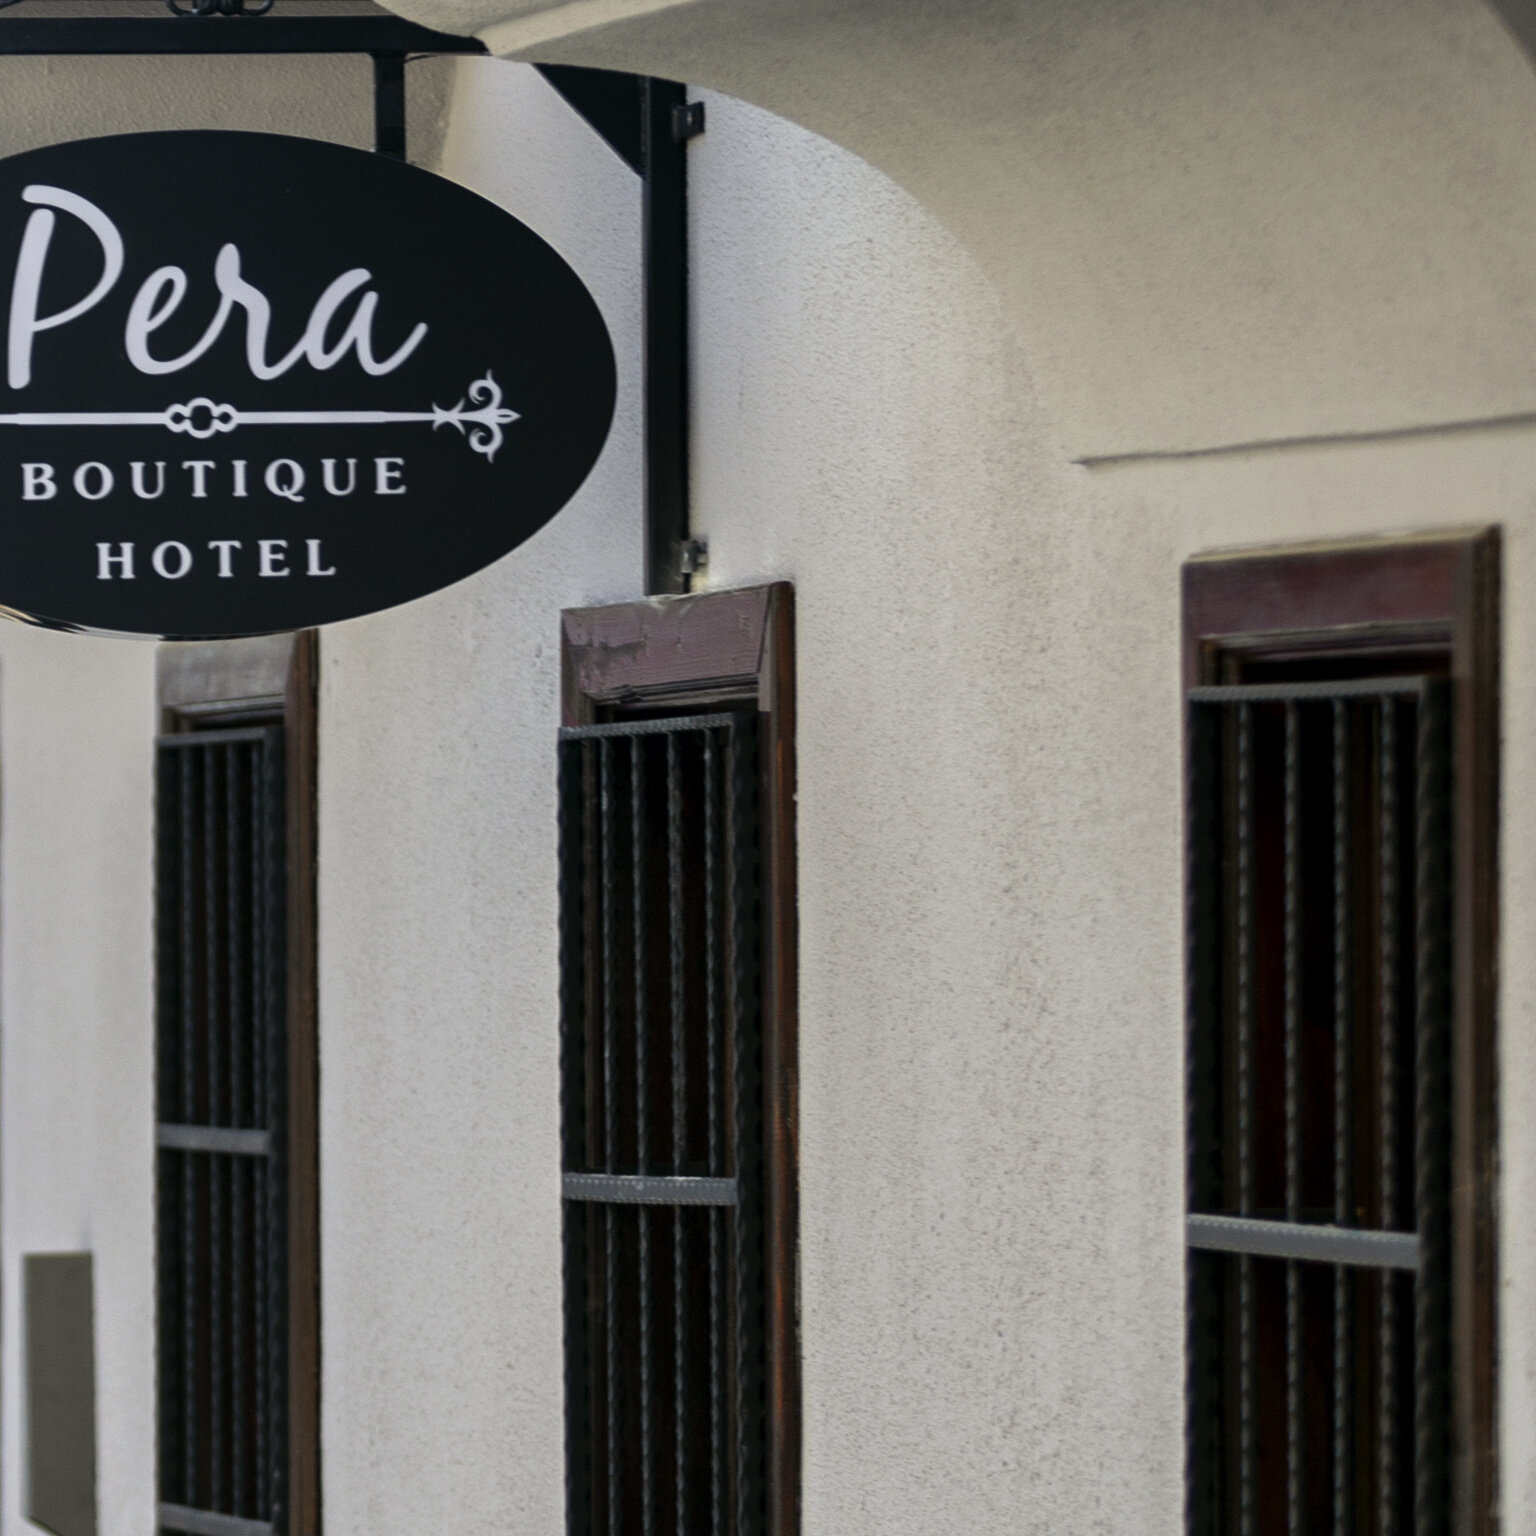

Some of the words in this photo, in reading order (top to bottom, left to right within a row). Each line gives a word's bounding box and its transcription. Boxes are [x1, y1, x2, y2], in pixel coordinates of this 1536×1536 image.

[7, 183, 428, 390] Pera
[20, 456, 408, 503] BOUTIQUE
[95, 538, 337, 581] HOTEL
